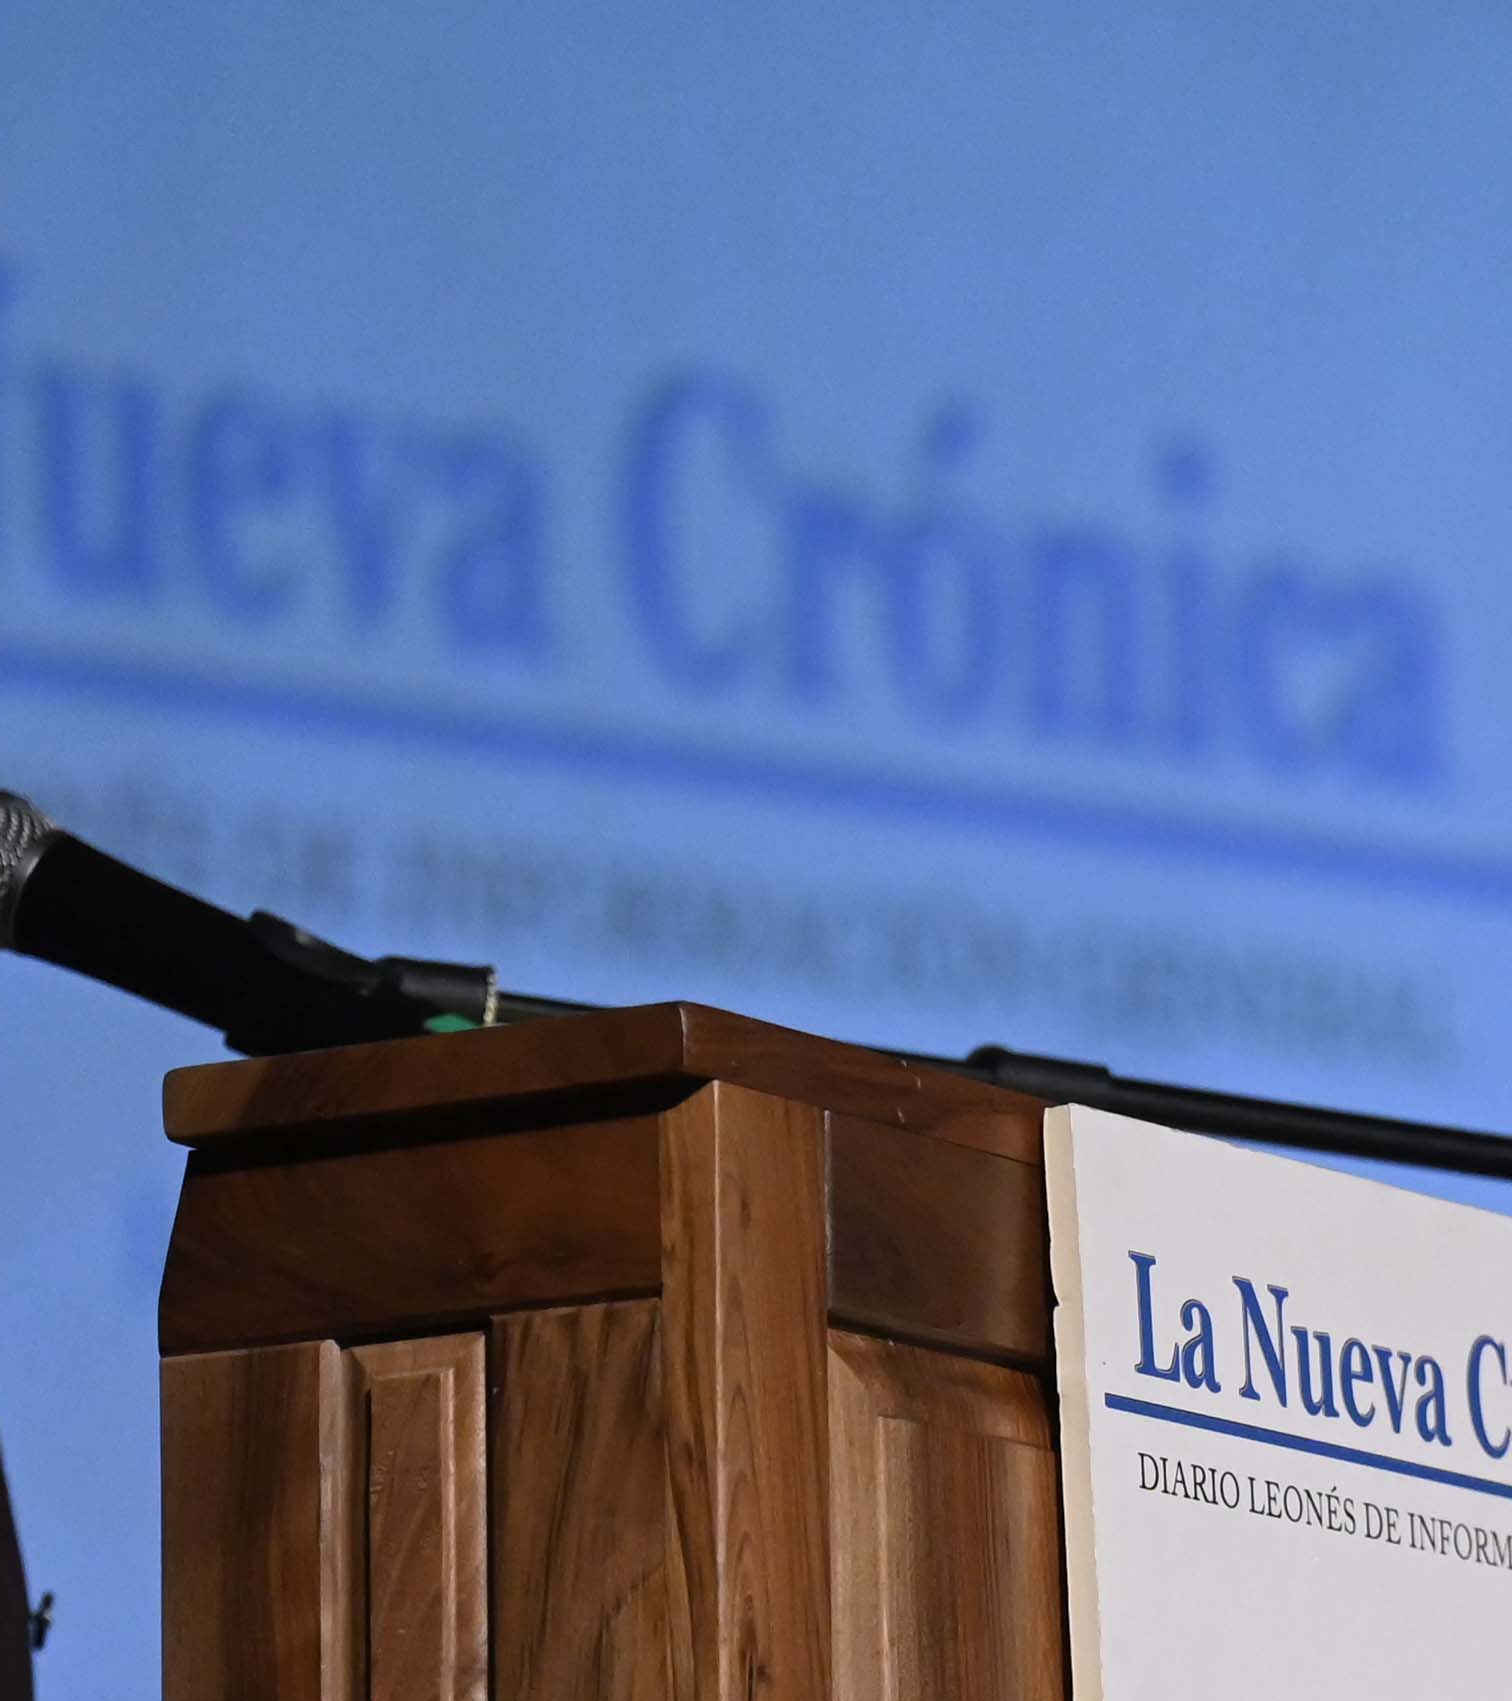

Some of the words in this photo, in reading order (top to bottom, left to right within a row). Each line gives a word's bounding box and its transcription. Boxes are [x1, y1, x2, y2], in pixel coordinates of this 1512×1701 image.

[618, 366, 1450, 796] Crónica
[1128, 1250, 1223, 1394] La
[1232, 1275, 1453, 1447] Nueva
[1137, 1451, 1241, 1510] DIARIO
[1247, 1475, 1357, 1536] LEONÉS
[1362, 1501, 1402, 1546] DE
